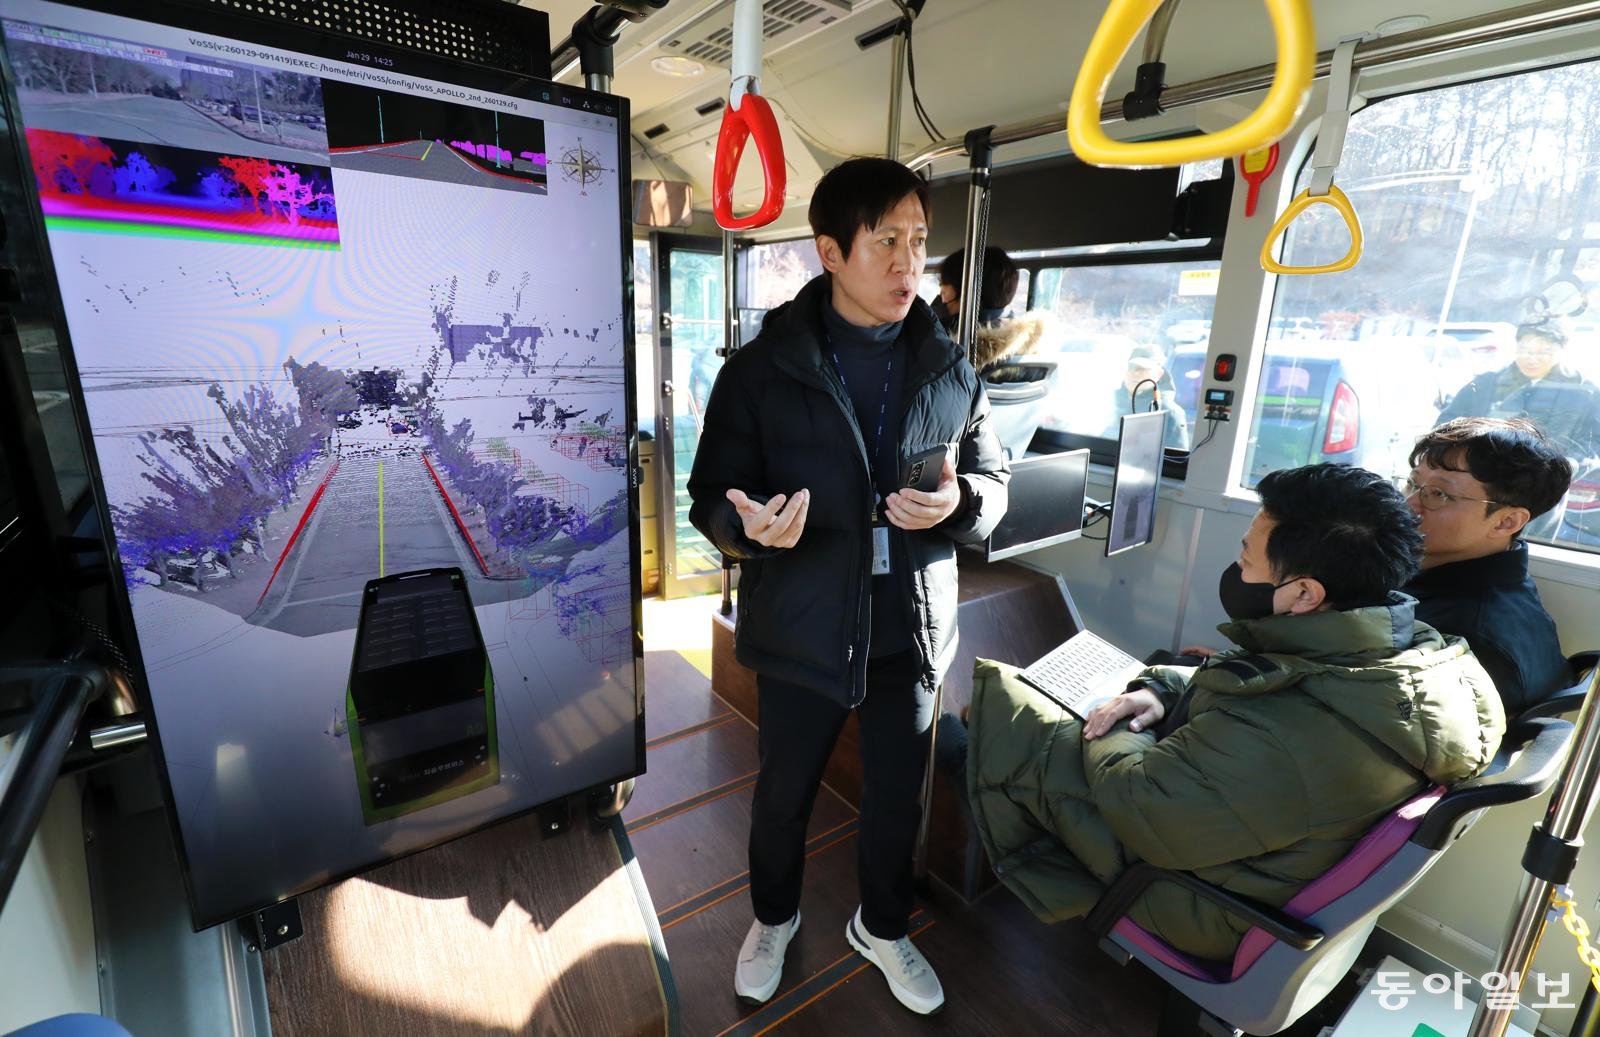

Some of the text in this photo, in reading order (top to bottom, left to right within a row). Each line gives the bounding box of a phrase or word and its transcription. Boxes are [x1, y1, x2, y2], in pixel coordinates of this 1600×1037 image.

[188, 38, 318, 69] VoSS(v:260129-091419)EXEC:
[346, 51, 393, 66] Jan 29 14:25
